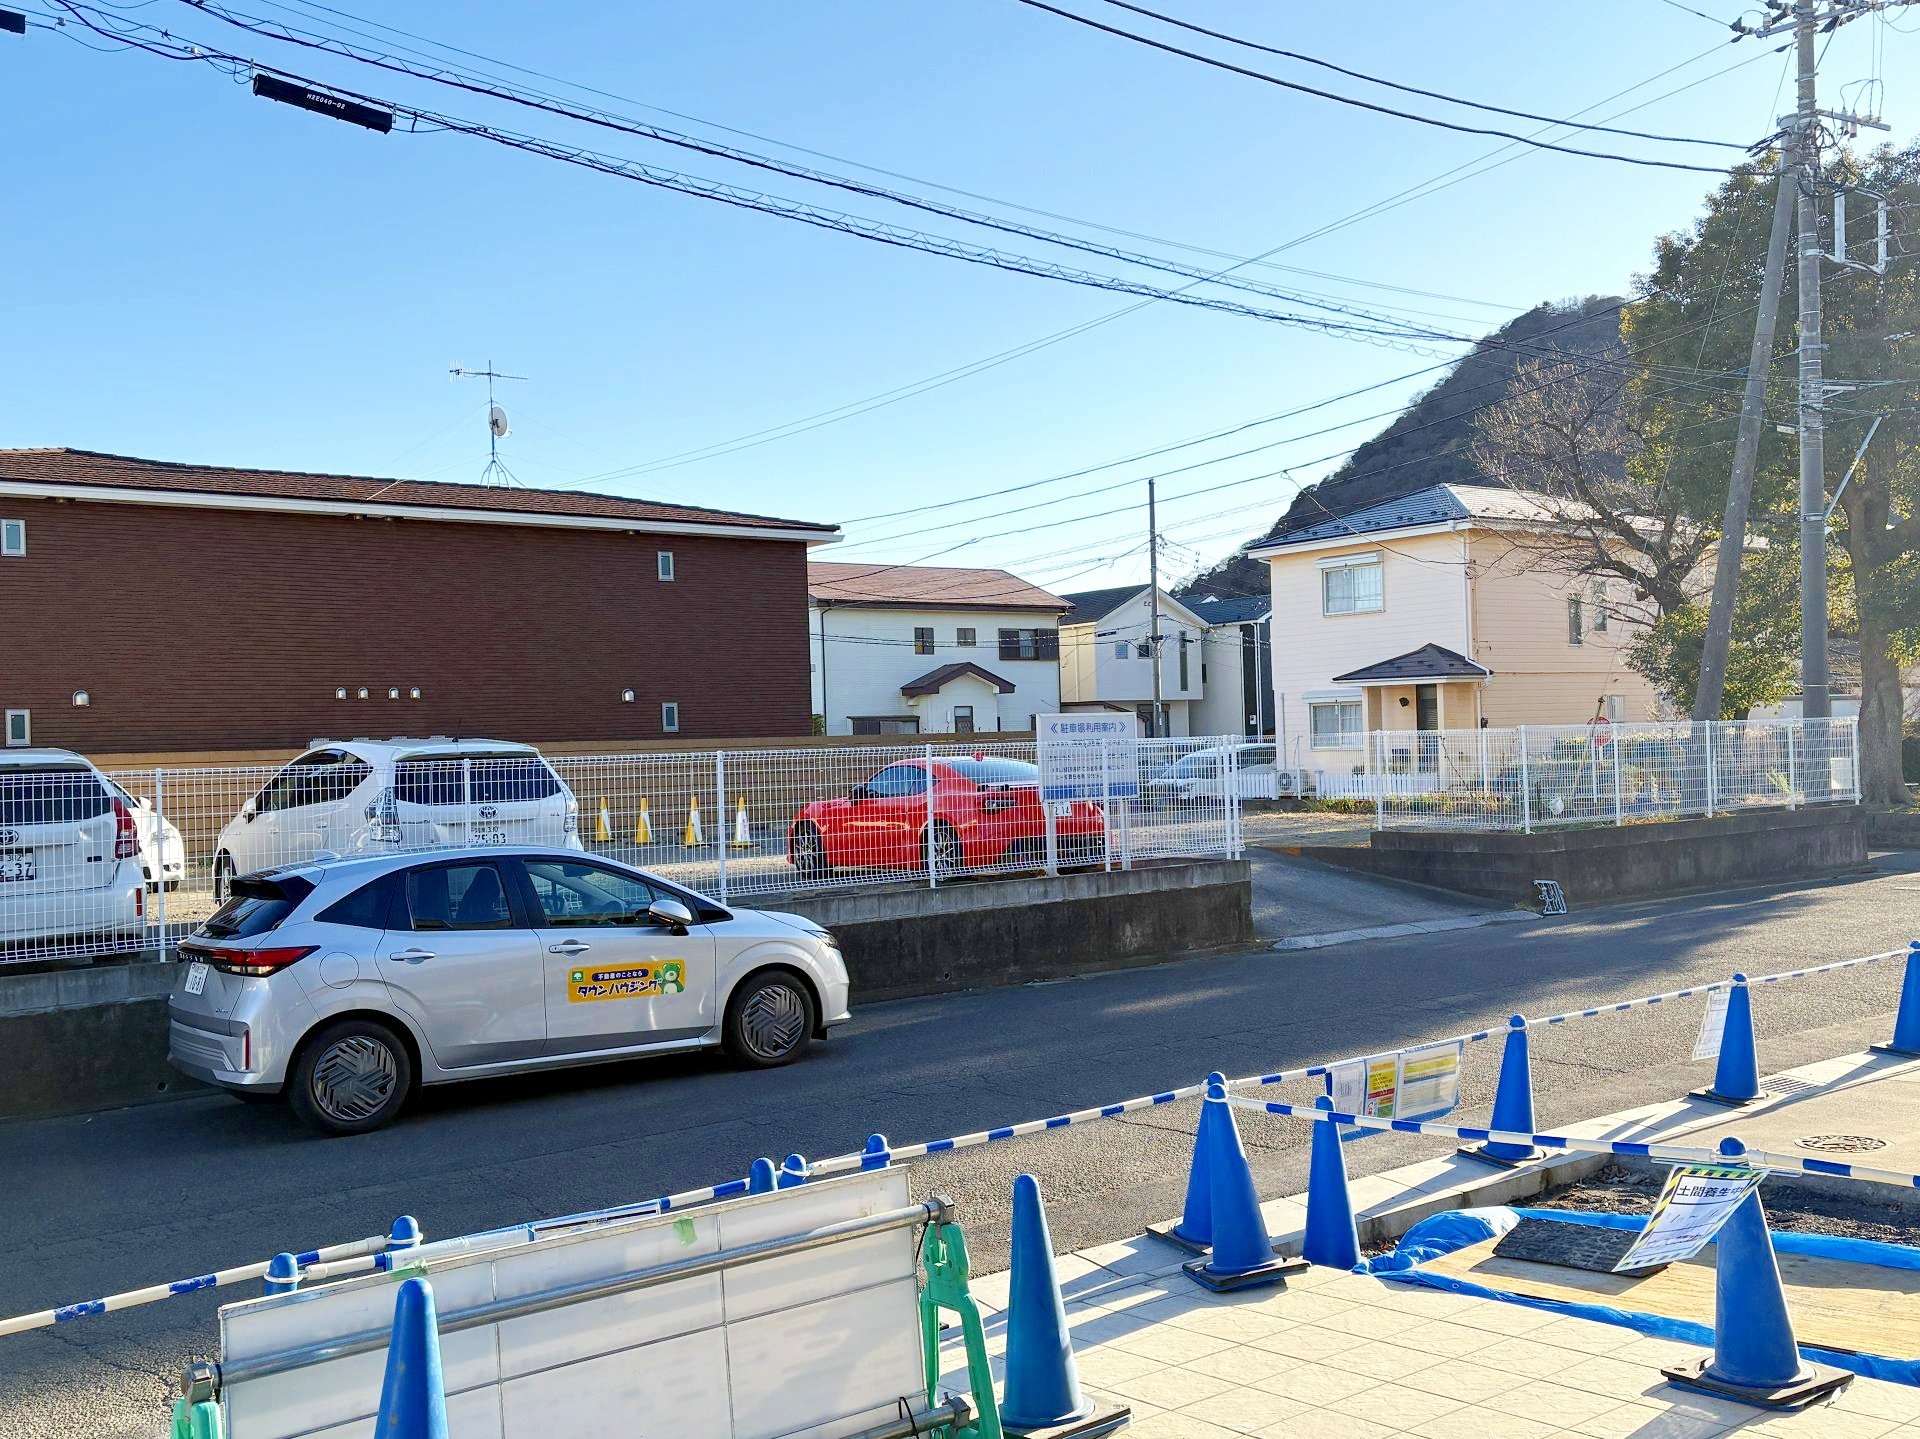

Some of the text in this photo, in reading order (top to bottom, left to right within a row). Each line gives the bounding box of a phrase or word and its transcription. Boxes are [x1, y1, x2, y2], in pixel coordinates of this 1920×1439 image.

[577, 978, 663, 997] タウンハウジング
[1676, 1185, 1743, 1198] 土間養生中
